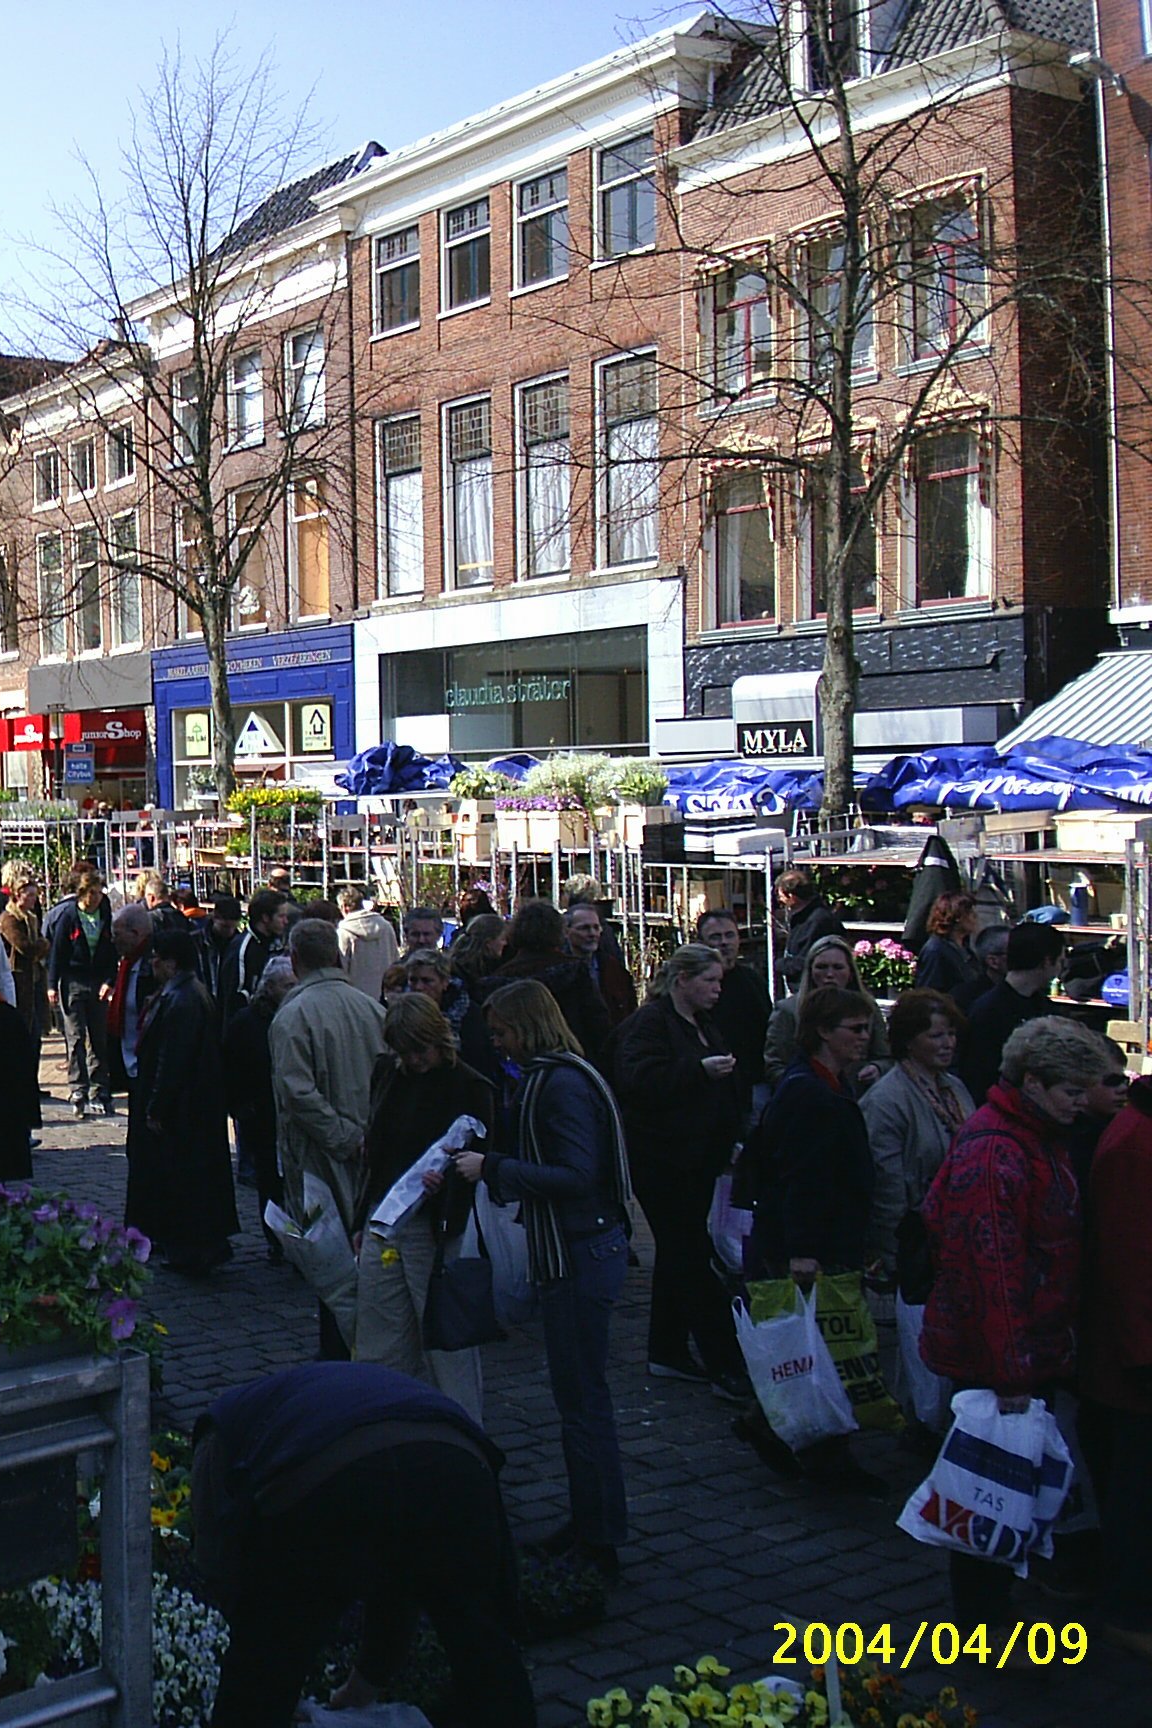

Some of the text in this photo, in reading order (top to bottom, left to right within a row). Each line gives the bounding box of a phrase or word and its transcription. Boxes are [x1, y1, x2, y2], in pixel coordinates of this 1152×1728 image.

[226, 657, 263, 672] POTHEKEN
[445, 674, 571, 707] claudia sträter
[743, 728, 808, 749] MYLA
[974, 1486, 1005, 1512] TAS
